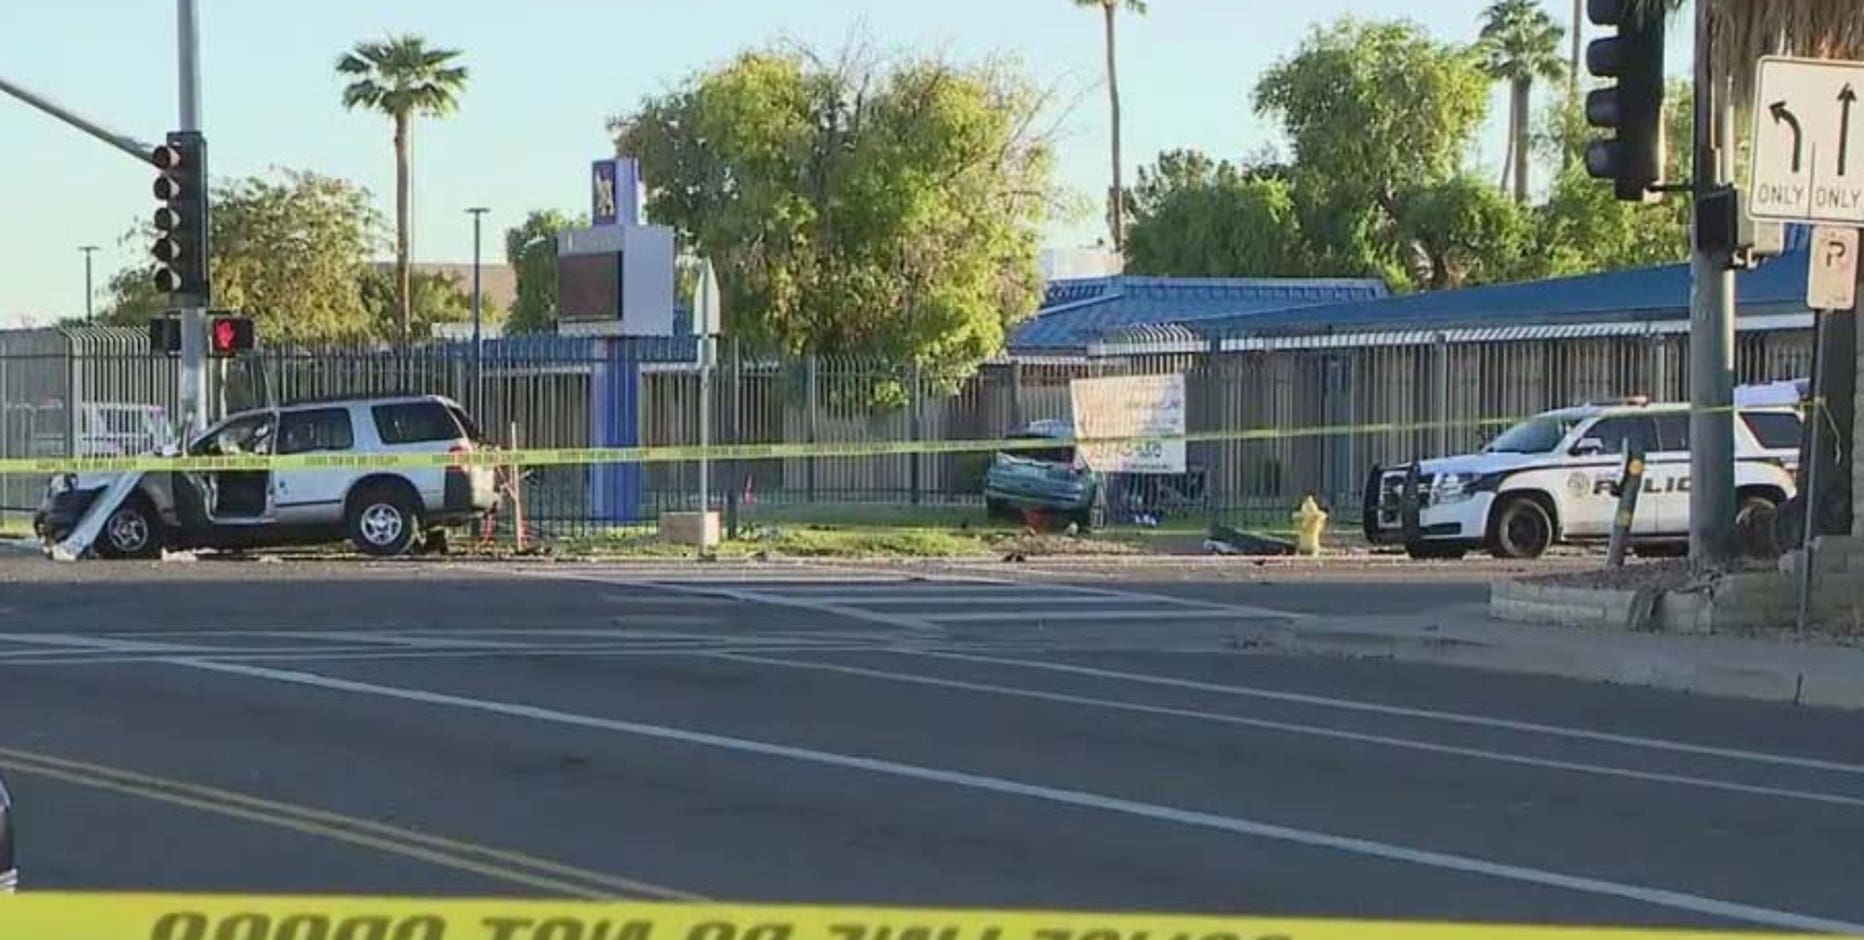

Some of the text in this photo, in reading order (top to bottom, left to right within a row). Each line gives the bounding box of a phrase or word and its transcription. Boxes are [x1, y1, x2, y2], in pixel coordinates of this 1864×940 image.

[1758, 183, 1804, 205] ONLY
[1815, 186, 1861, 208] ONLY
[1593, 477, 1691, 497] PLIC
